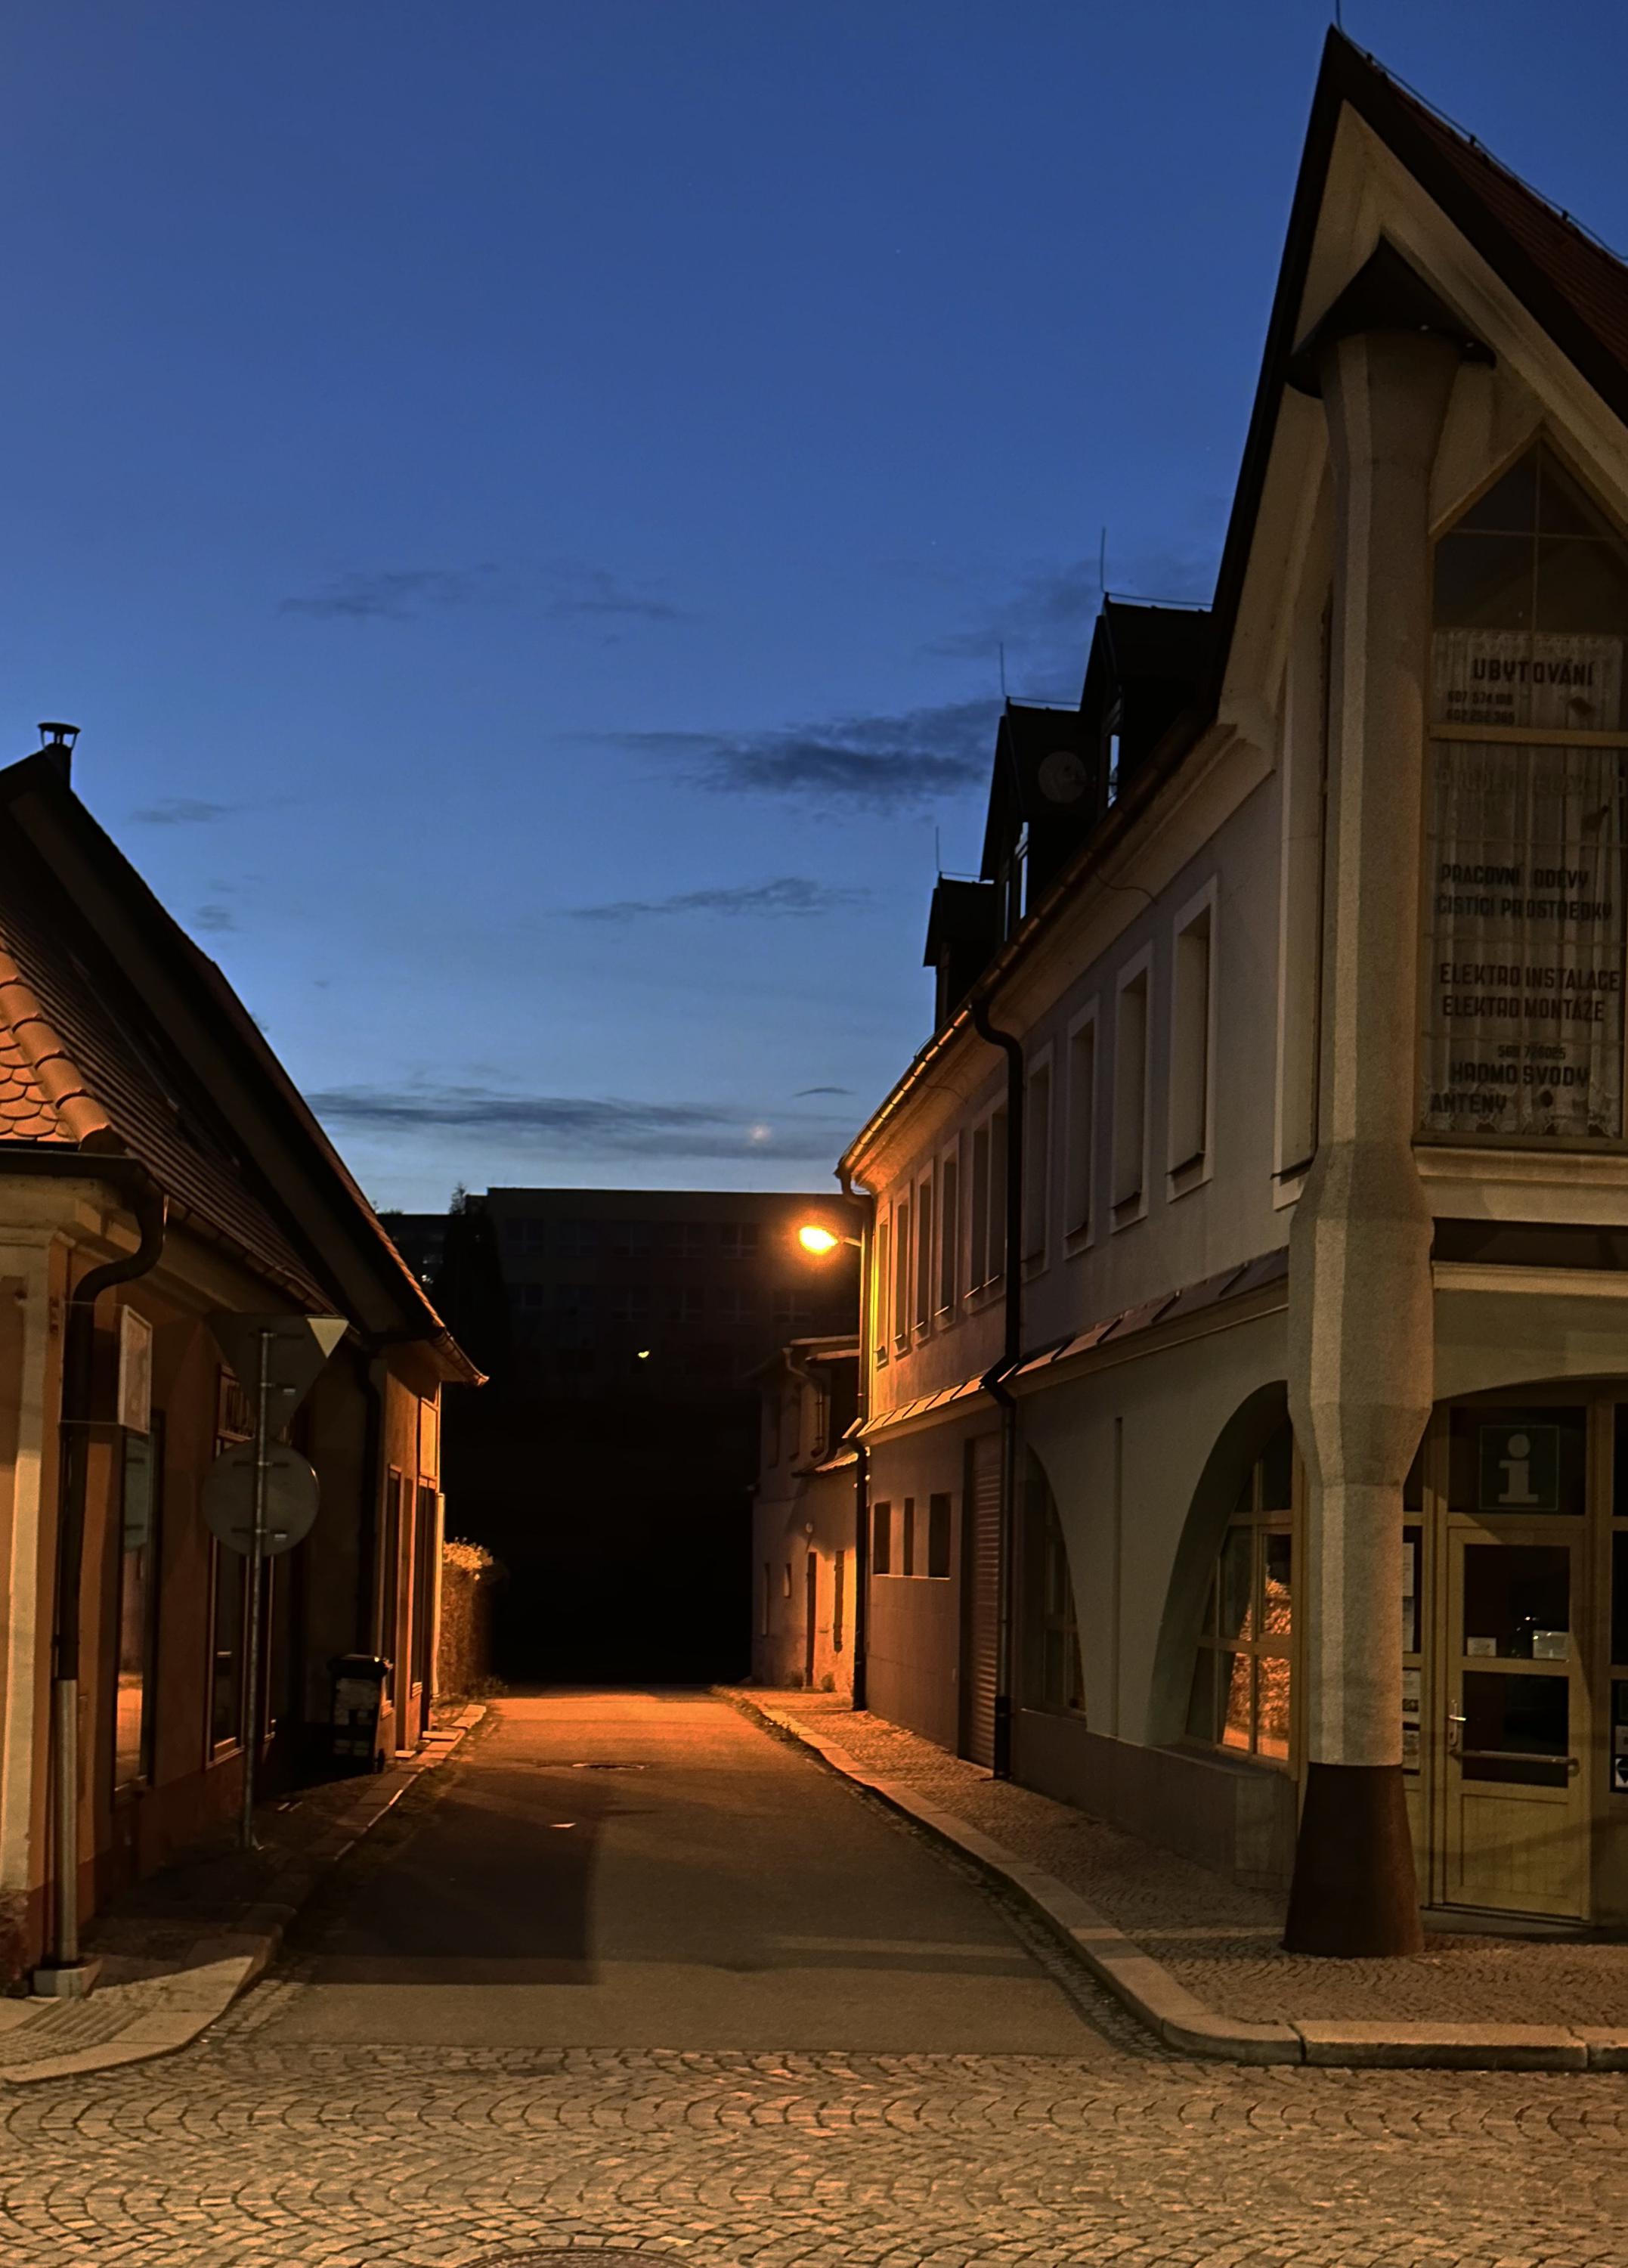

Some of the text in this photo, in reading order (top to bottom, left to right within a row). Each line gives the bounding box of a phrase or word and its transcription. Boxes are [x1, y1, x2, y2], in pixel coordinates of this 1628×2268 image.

[1473, 658, 1595, 686] UBYTOVÁNÍ
[1441, 863, 1524, 886] PRACOVNÍ
[1431, 1092, 1507, 1114] ANTENY
